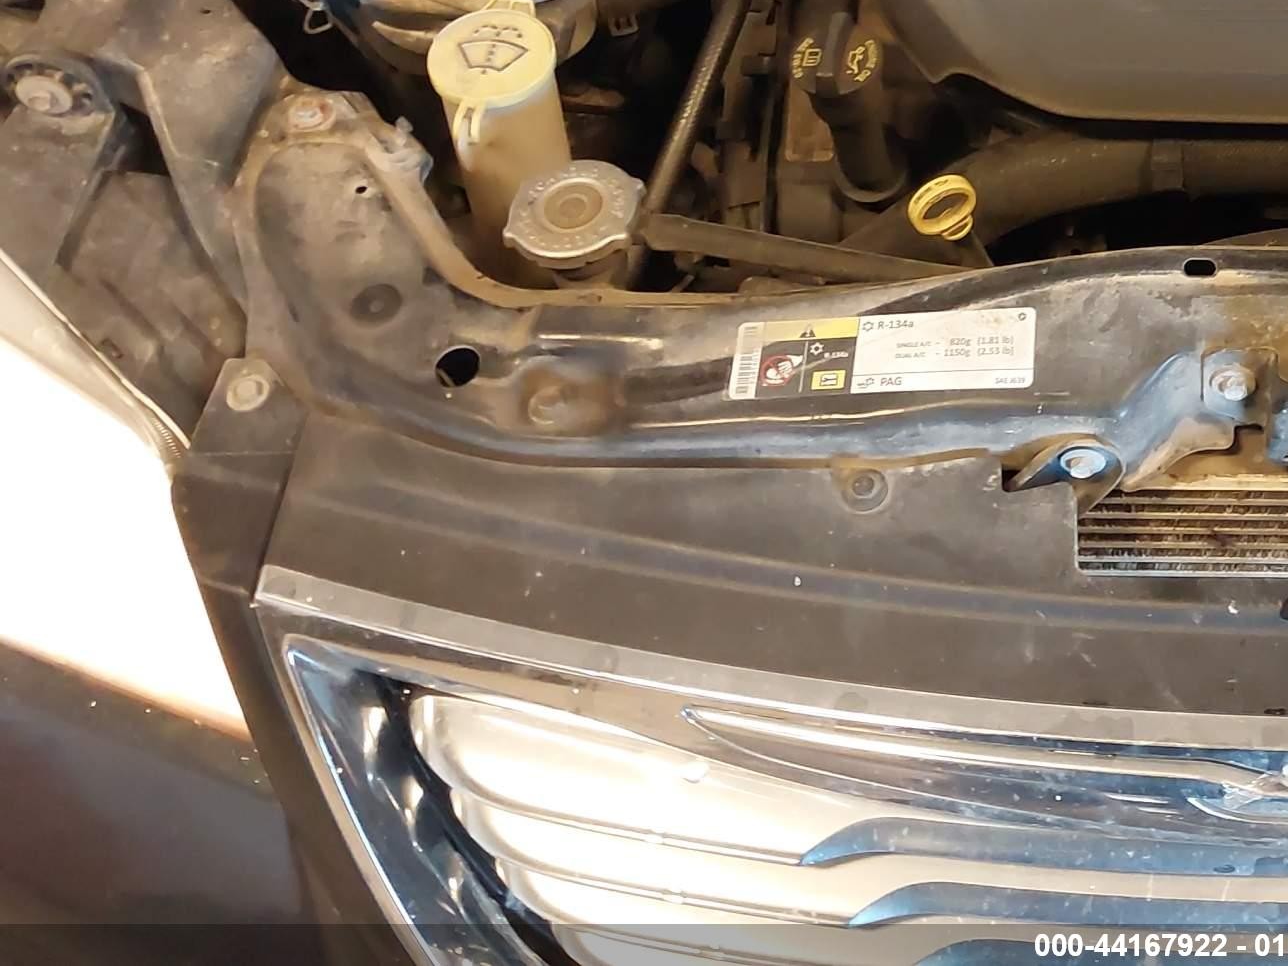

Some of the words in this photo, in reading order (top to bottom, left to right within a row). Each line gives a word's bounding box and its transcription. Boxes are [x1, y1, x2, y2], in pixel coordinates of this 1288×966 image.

[877, 319, 914, 329] R-134a
[949, 338, 972, 347] 820g
[880, 376, 903, 386] PAG
